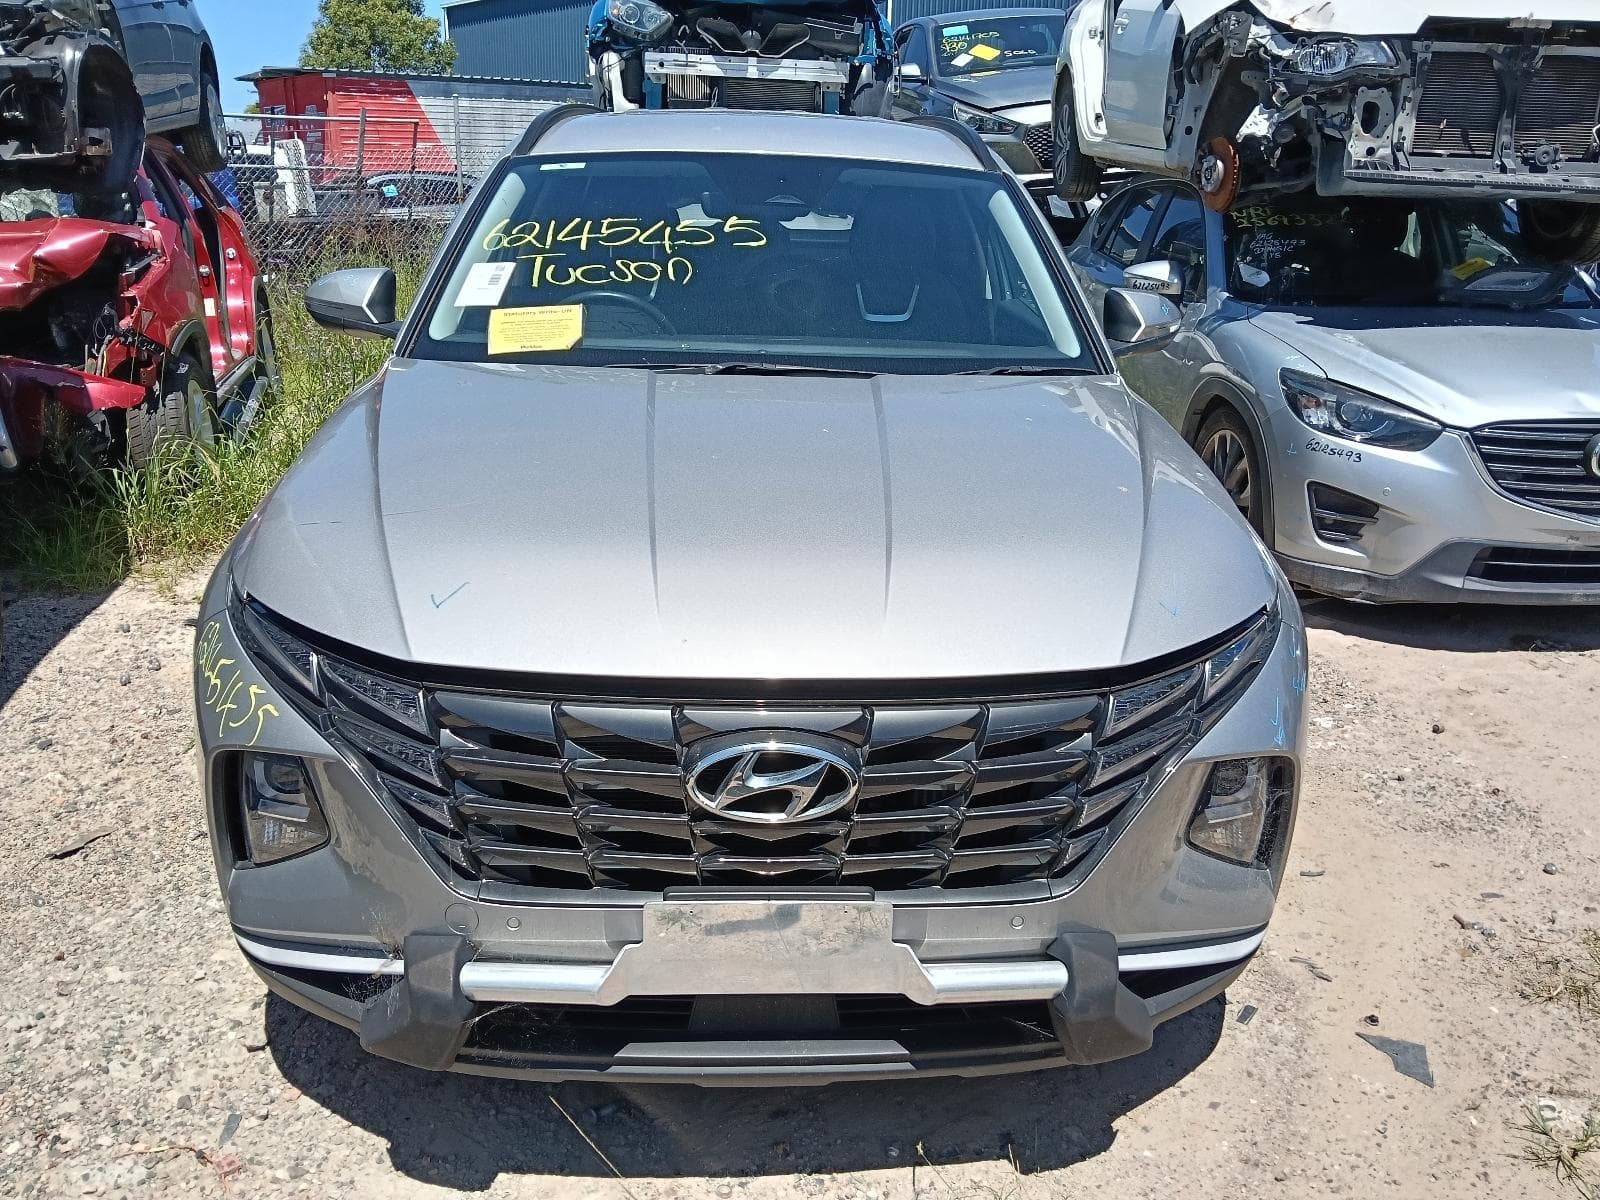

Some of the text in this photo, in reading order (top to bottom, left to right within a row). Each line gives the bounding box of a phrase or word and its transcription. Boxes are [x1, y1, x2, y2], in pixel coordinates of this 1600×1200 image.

[482, 216, 767, 254] 62145455
[516, 252, 693, 288] Tucson
[1305, 437, 1362, 463] 62125493
